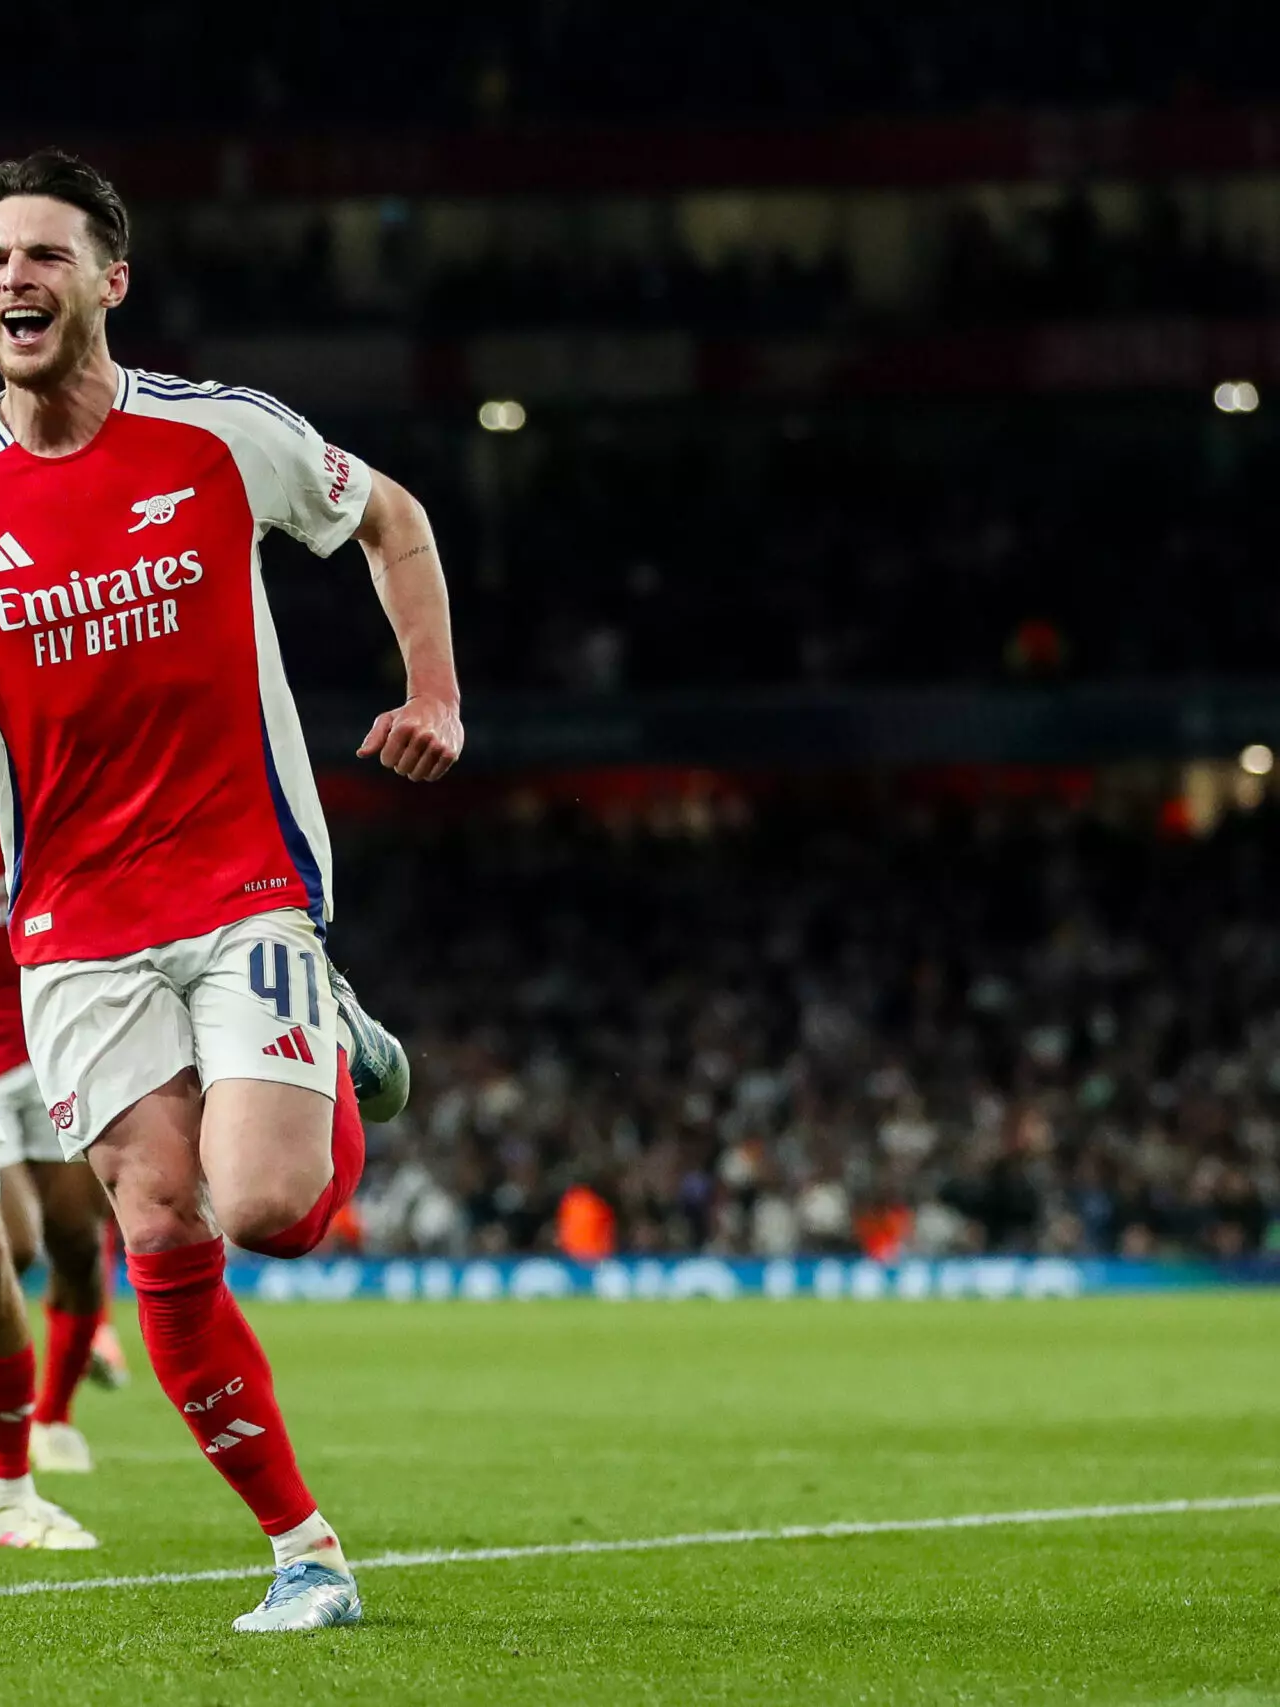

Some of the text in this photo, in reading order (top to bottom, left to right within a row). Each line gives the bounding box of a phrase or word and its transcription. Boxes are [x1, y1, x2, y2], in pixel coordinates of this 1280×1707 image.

[33, 598, 180, 667] FLY BETTER
[248, 940, 320, 1029] 41
[183, 1376, 244, 1413] AFC
